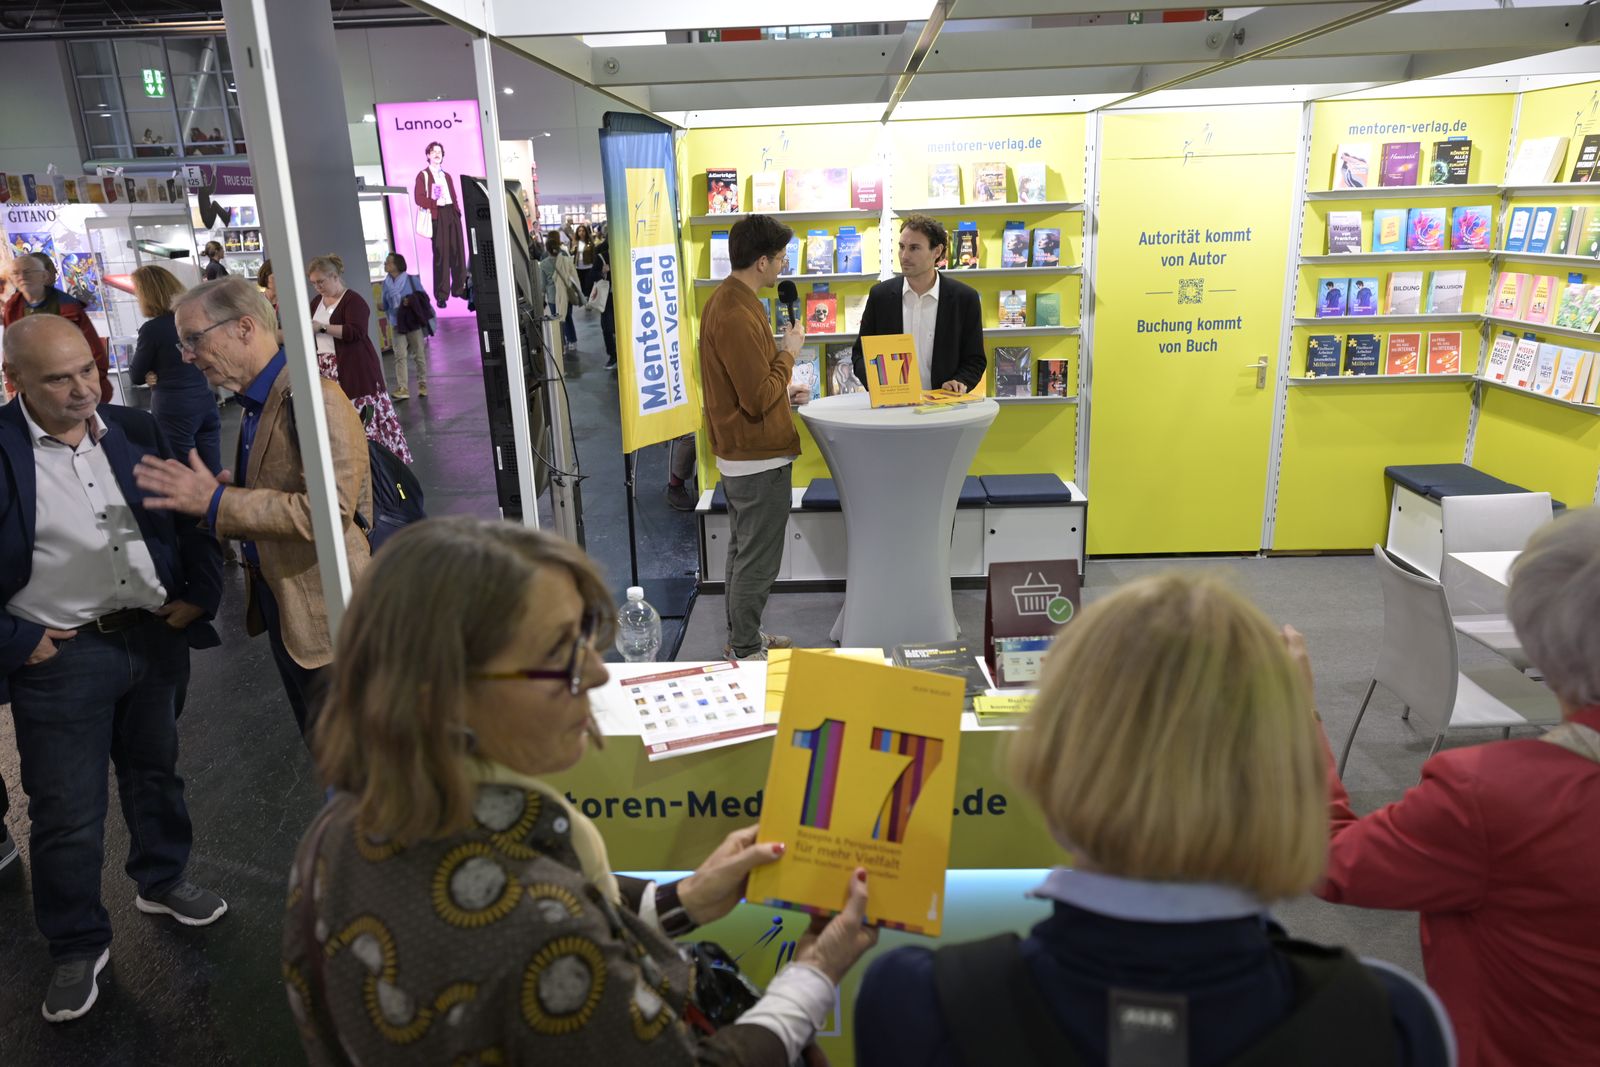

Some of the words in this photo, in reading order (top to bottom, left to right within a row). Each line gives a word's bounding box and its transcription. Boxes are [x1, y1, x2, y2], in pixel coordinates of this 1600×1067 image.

[395, 117, 452, 131] Lannoo
[1348, 119, 1467, 136] mentoren-verlag.de
[927, 136, 1042, 153] mentoren-verlag.de
[188, 168, 194, 178] F
[222, 175, 240, 187] TRUE
[8, 209, 57, 223] GITANO
[1333, 224, 1359, 232] Würger
[1138, 229, 1201, 246] Autorität
[1205, 227, 1252, 243] kommt
[1161, 255, 1185, 267] von
[1188, 251, 1227, 266] Autor
[658, 254, 678, 334] Verlag
[1136, 318, 1193, 334] Buchung
[1197, 315, 1243, 331] kommt
[635, 256, 668, 411] Mentoren
[1159, 342, 1182, 354] von
[1186, 338, 1218, 352] Buch
[1491, 357, 1503, 366] REICH
[1492, 352, 1507, 361] ERFOLG
[1514, 358, 1531, 367] ERFOLG
[669, 340, 682, 402] Media
[870, 353, 912, 385] 17
[1513, 364, 1526, 372] REICH
[791, 718, 944, 845] 17
[565, 790, 764, 819] toren-Med
[953, 787, 1007, 816] .de
[795, 840, 814, 853] für
[817, 847, 850, 860] mehr
[855, 851, 900, 871] Vielfalt
